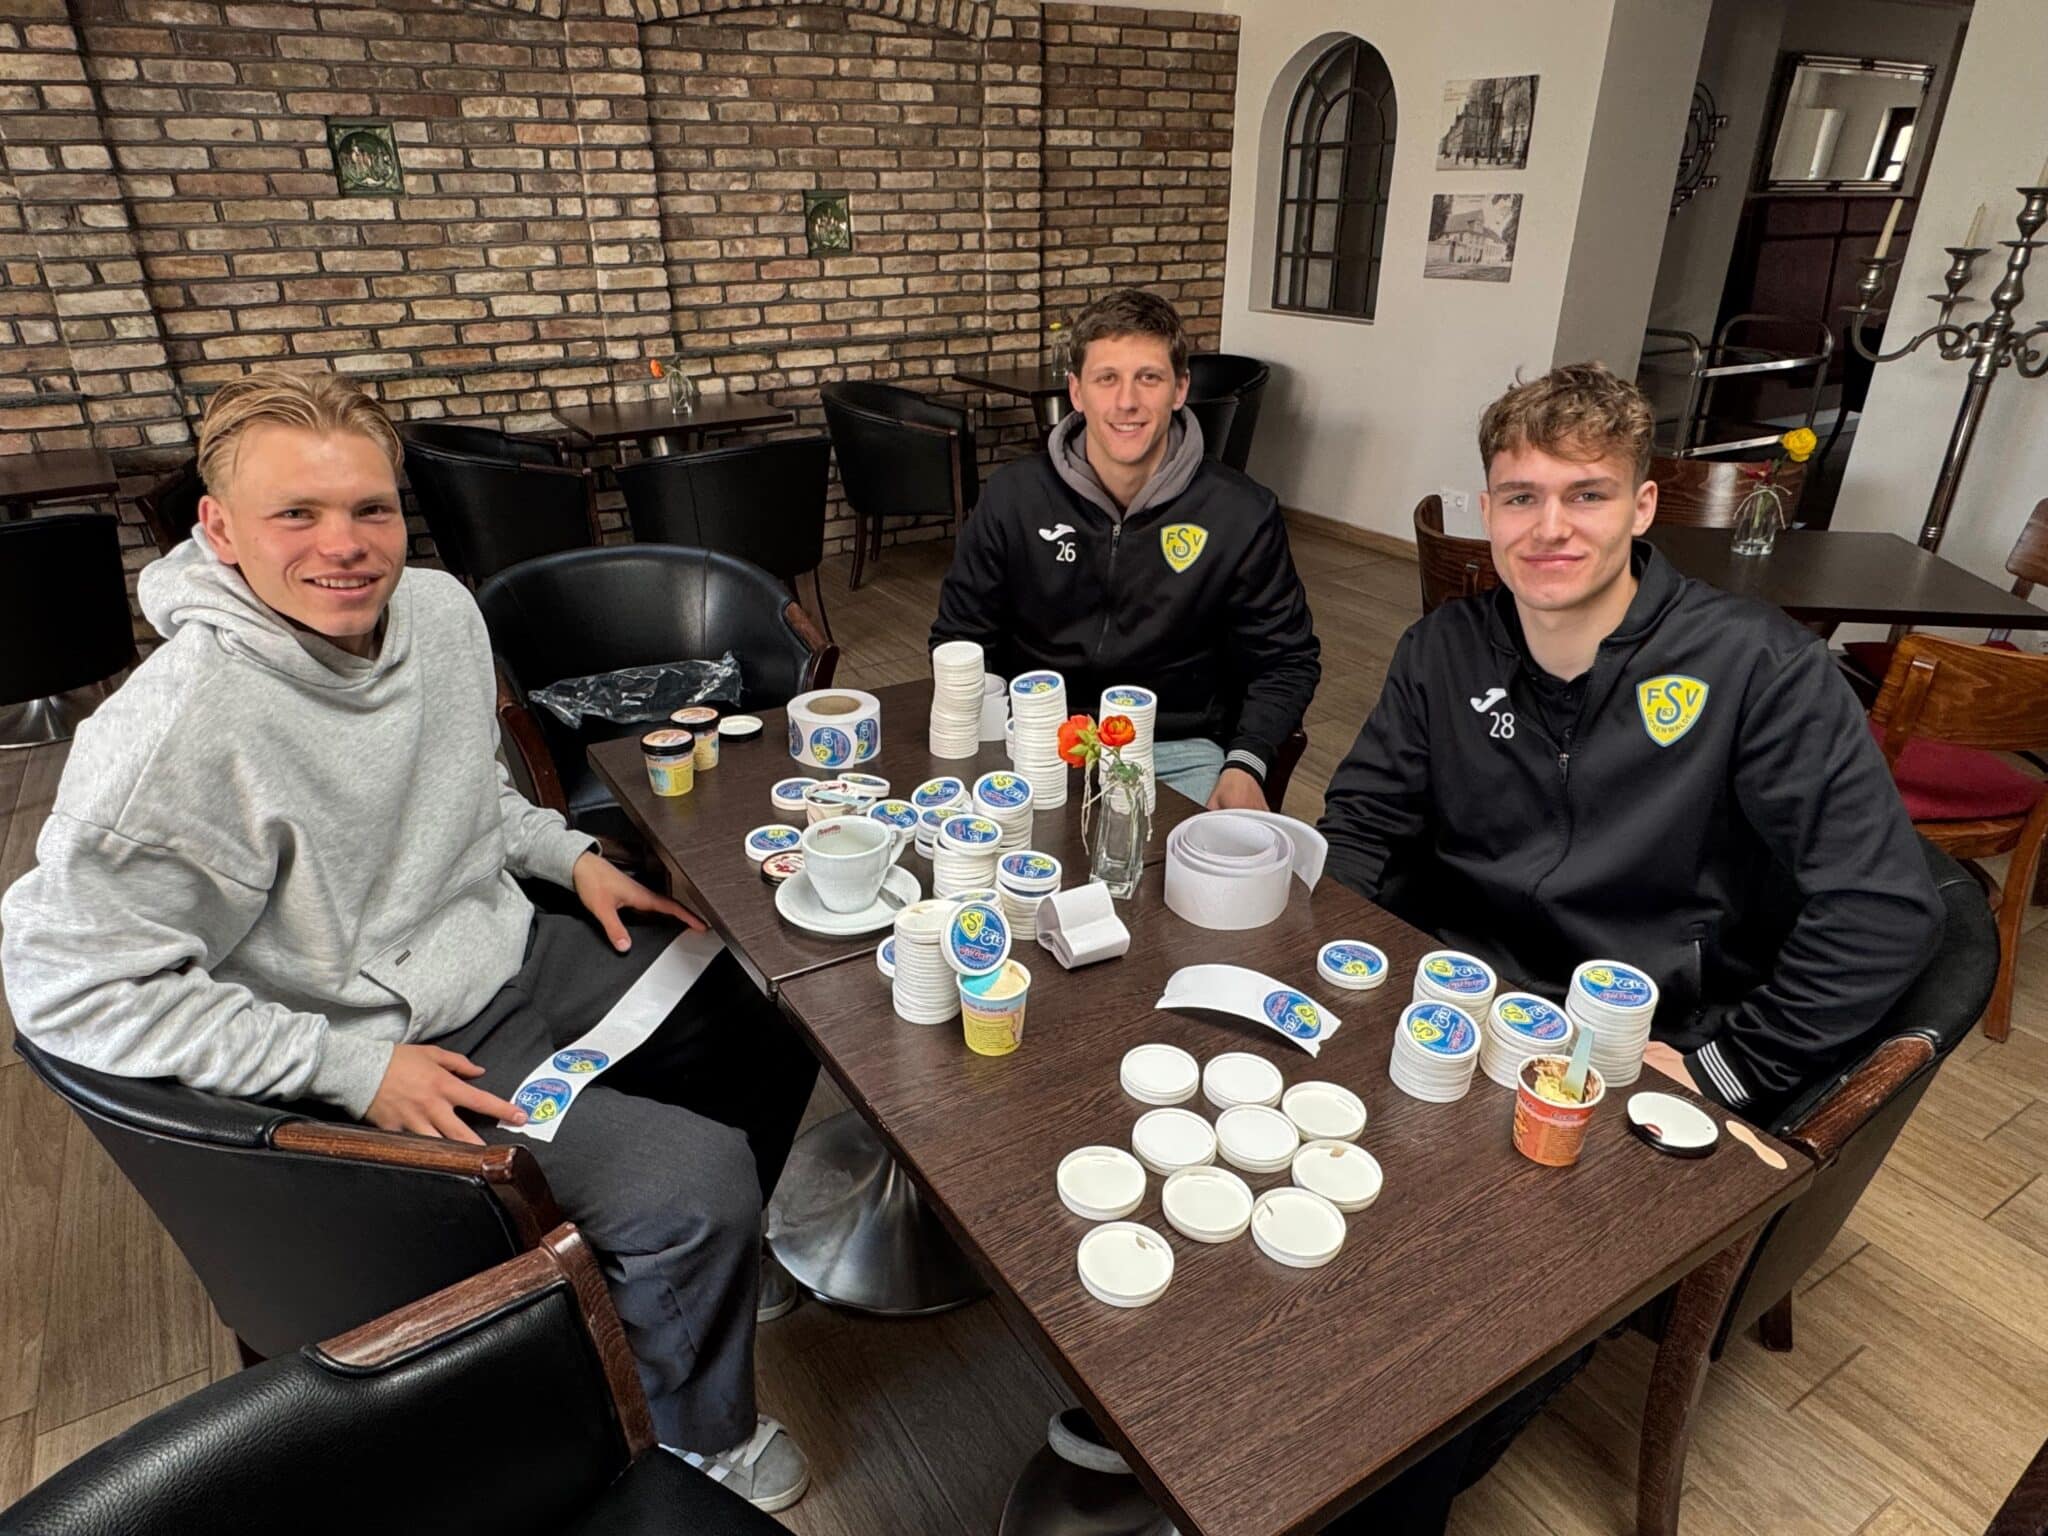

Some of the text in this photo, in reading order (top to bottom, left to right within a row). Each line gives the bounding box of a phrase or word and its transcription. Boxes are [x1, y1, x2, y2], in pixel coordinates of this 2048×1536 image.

[1056, 541, 1076, 562] 26
[1166, 528, 1202, 558] FSV
[1647, 681, 1700, 725] FSV
[1489, 711, 1515, 739] 28
